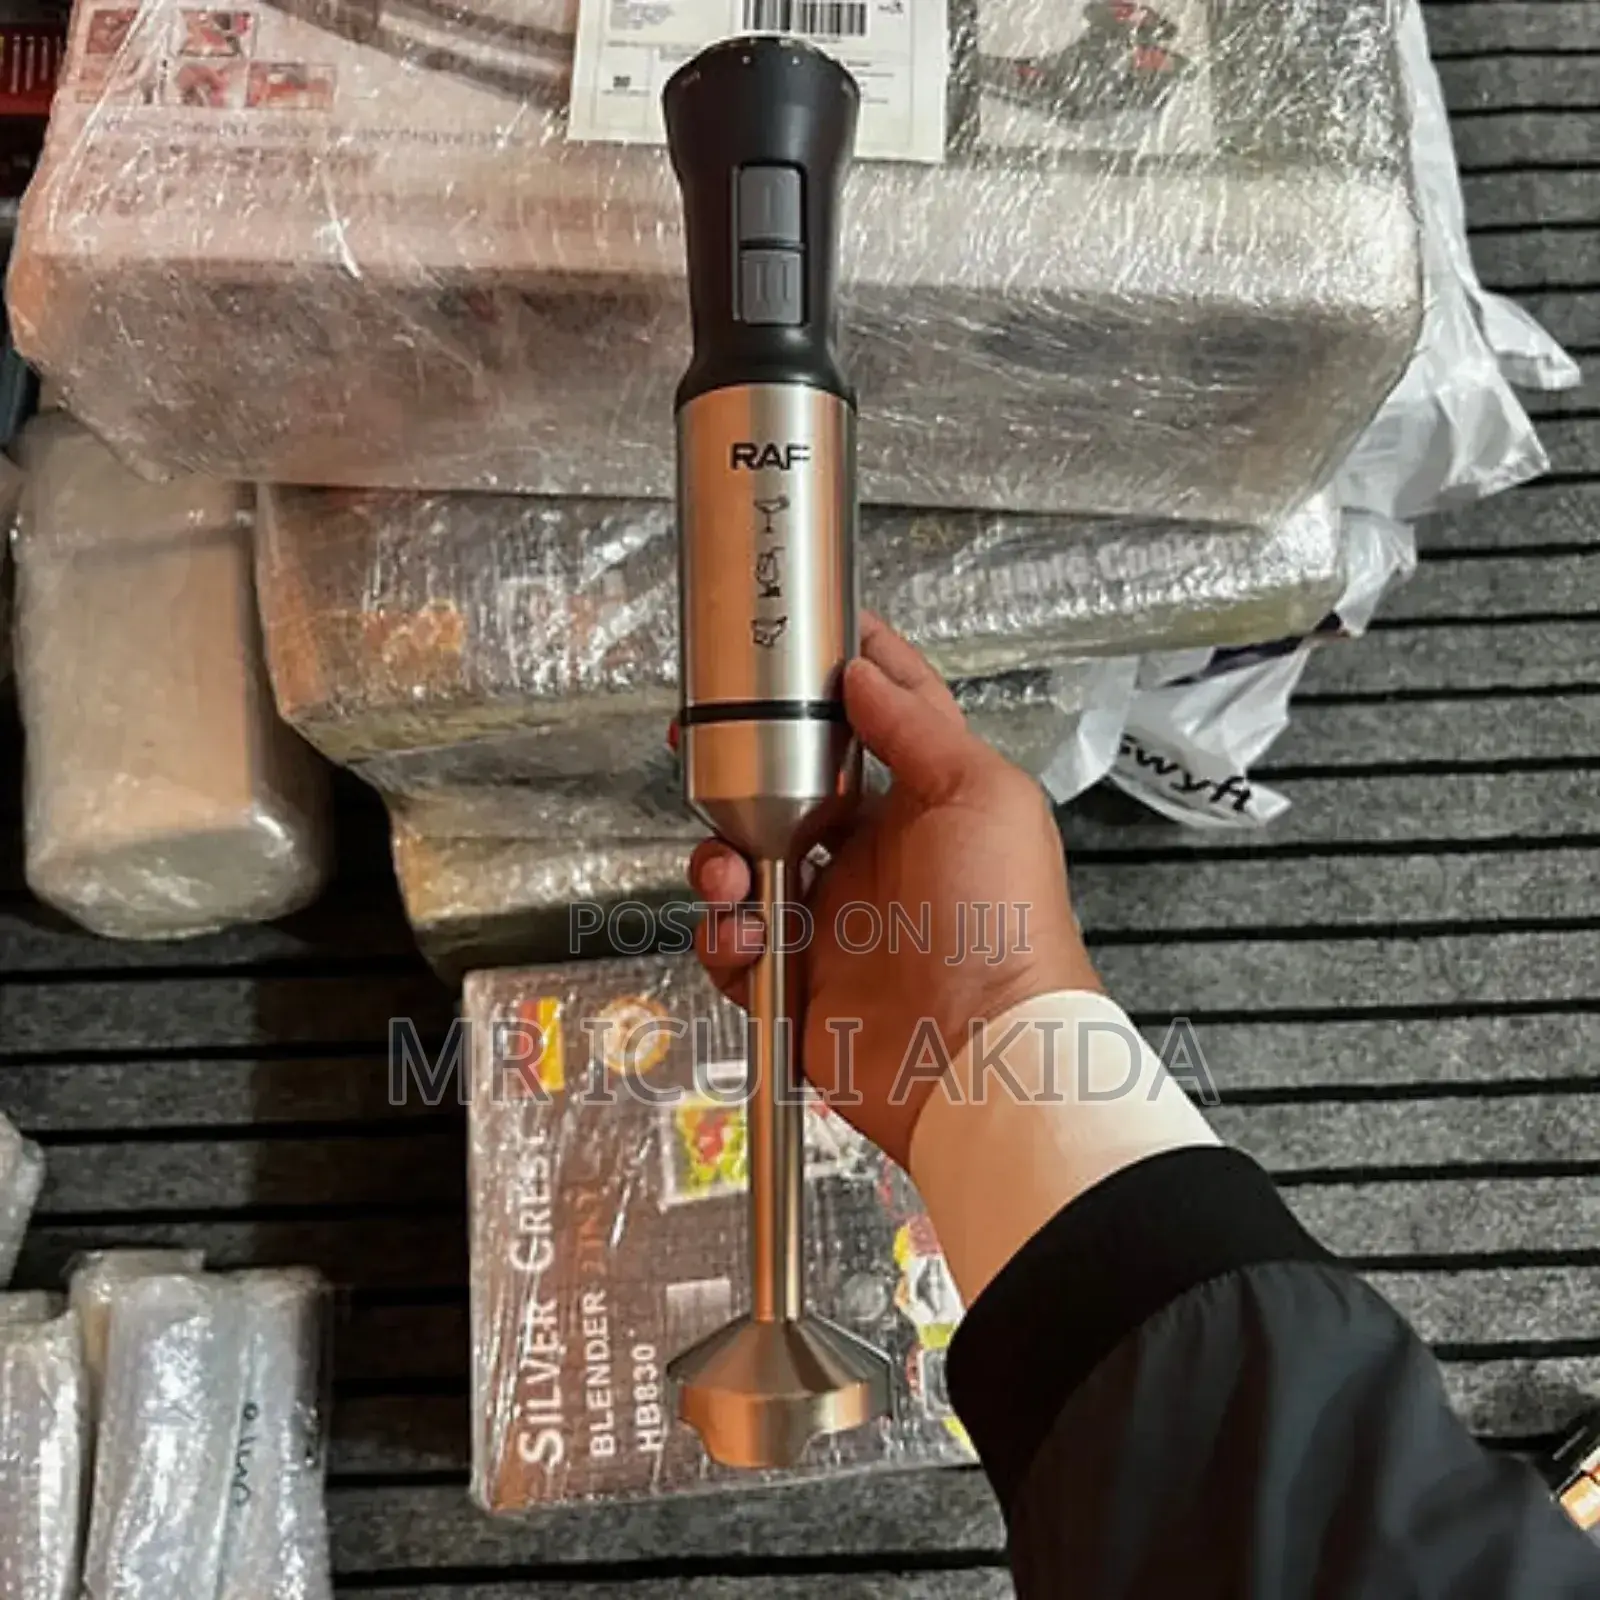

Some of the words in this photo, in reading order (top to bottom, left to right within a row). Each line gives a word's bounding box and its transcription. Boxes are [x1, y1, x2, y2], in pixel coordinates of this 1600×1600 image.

[731, 443, 811, 471] RAF
[519, 1299, 564, 1468] SILVER
[582, 1288, 616, 1457] BLENDER
[631, 1343, 665, 1452] HB830
